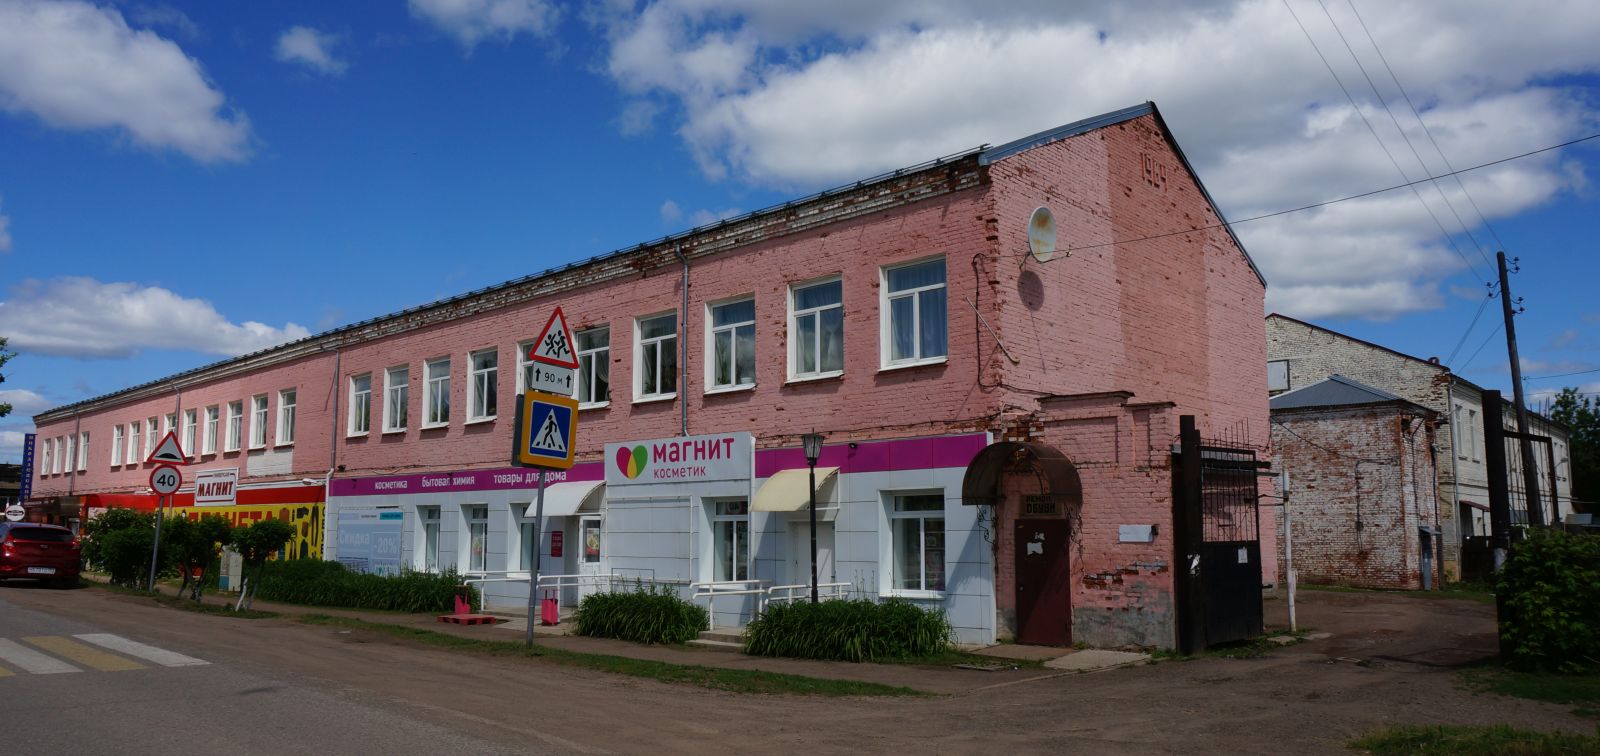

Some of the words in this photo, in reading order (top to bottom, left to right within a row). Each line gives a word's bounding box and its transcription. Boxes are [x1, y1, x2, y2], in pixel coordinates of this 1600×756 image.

[544, 372, 556, 383] 90
[653, 466, 706, 479] косметик
[156, 474, 176, 487] 40
[374, 480, 408, 490] косметика
[421, 476, 451, 488] бытовая
[452, 476, 475, 486] химия
[493, 473, 523, 486] товары
[544, 471, 567, 484] дома
[197, 481, 234, 497] МАГНИТ
